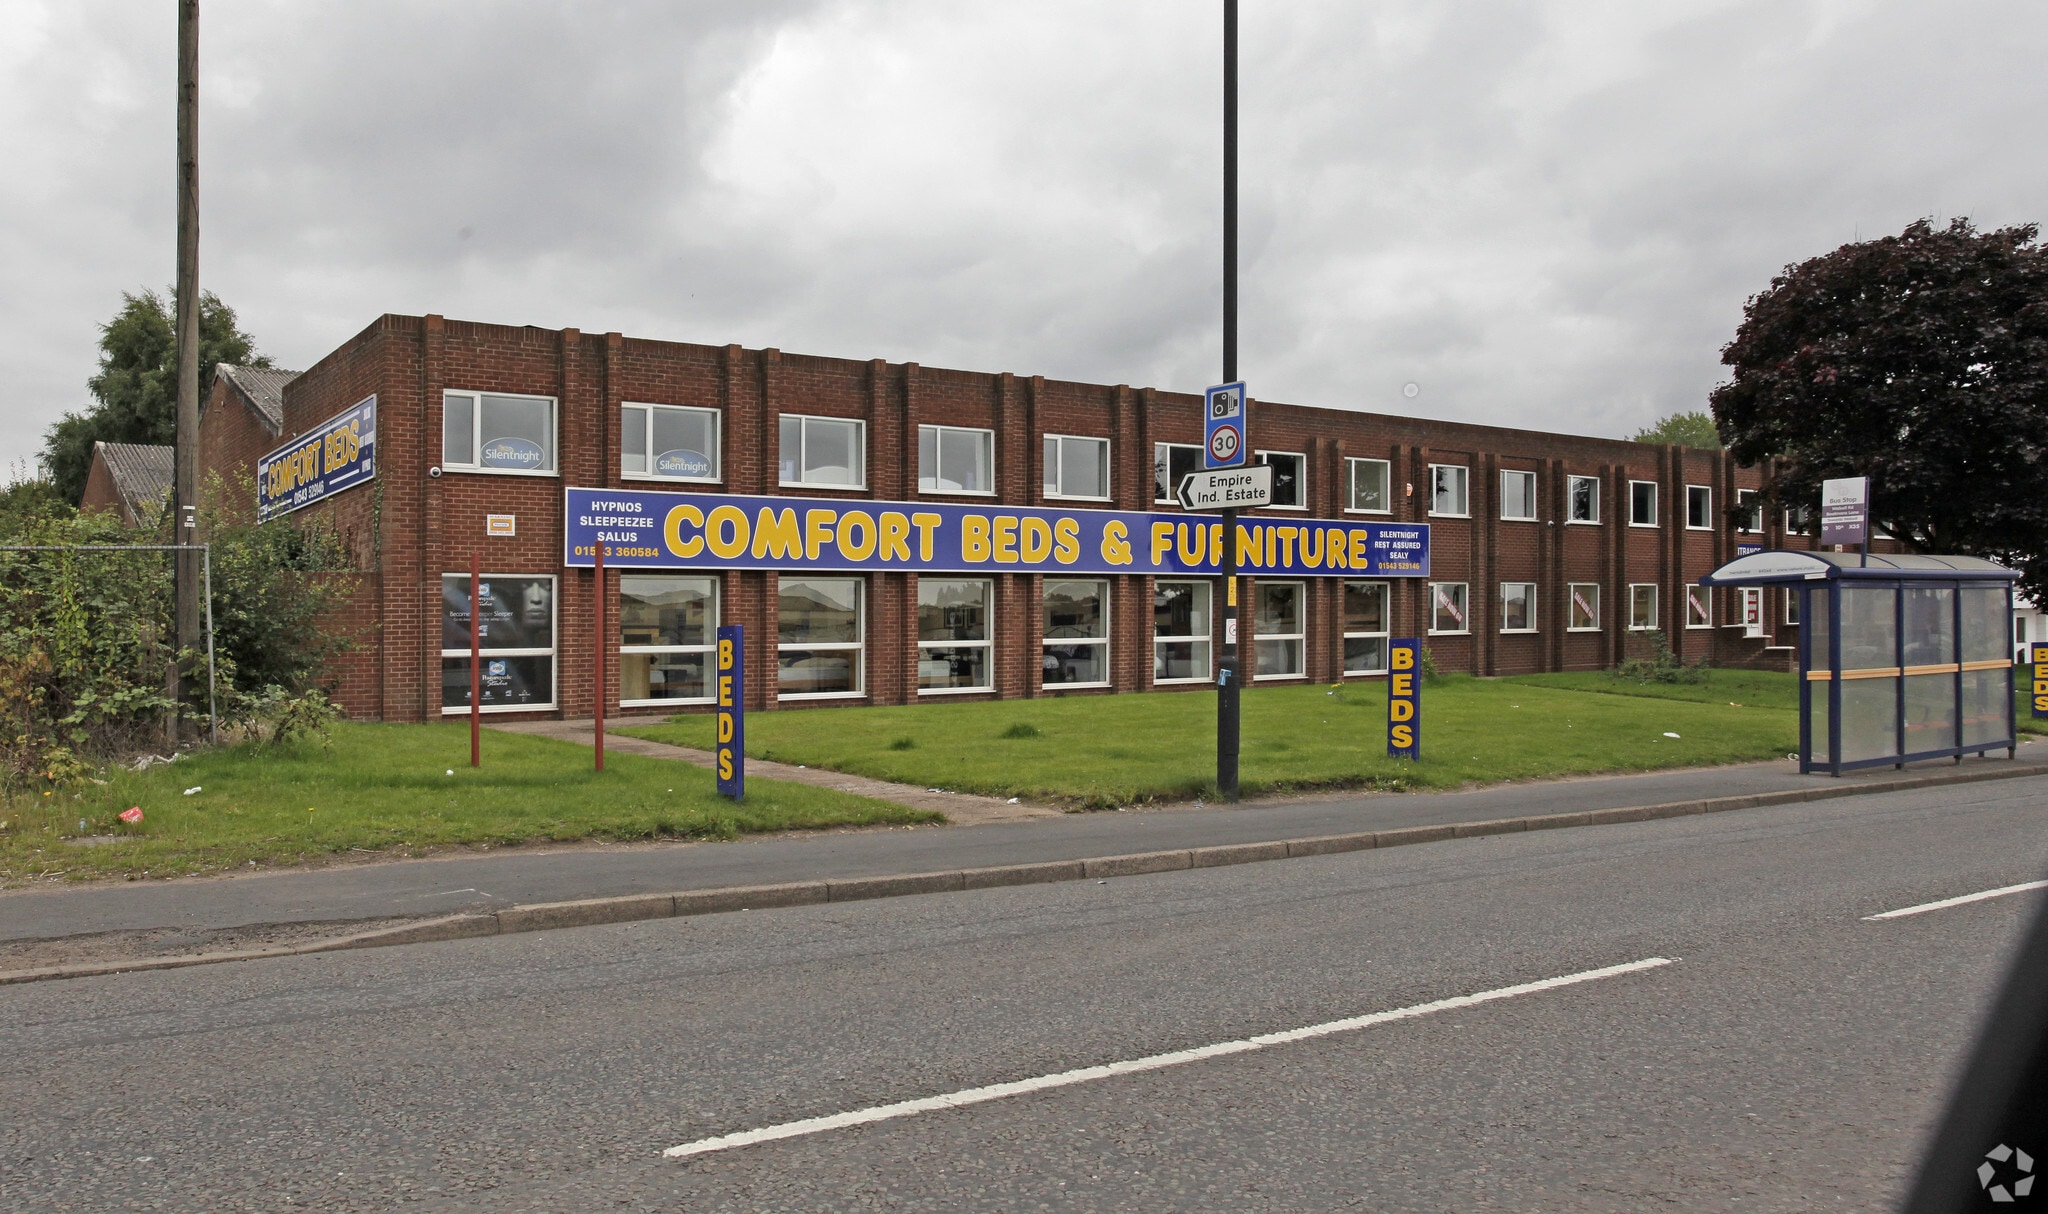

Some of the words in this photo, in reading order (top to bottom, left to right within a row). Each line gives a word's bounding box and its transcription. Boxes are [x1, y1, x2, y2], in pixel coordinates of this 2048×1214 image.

[1214, 436, 1236, 452] 30
[267, 438, 321, 499] COMFORT
[324, 418, 359, 475] BEDS
[485, 448, 540, 462] Silentnight
[660, 459, 708, 474] Silentnight
[1209, 474, 1252, 488] Empire
[1197, 491, 1220, 503] Ind.
[1225, 488, 1266, 501] Estate
[591, 501, 643, 513] HYPNOS
[580, 516, 654, 528] SLEEPEEZEE
[597, 532, 638, 542] SALUS
[664, 504, 942, 562] COMFORT
[962, 514, 1080, 564] BEDS
[1100, 520, 1133, 565] &
[1379, 530, 1420, 539] SILENTNIGHT
[574, 546, 612, 556] 0153
[616, 547, 660, 558] 360584
[1374, 541, 1390, 549] REST
[1392, 542, 1422, 550] ASSURED
[1389, 552, 1409, 560] SEALY
[1378, 562, 1398, 570] 01543
[493, 610, 514, 618] Sleeper
[2033, 647, 2048, 711] BEDS
[1391, 647, 1414, 748] BEDS
[718, 639, 733, 781] BEDS
